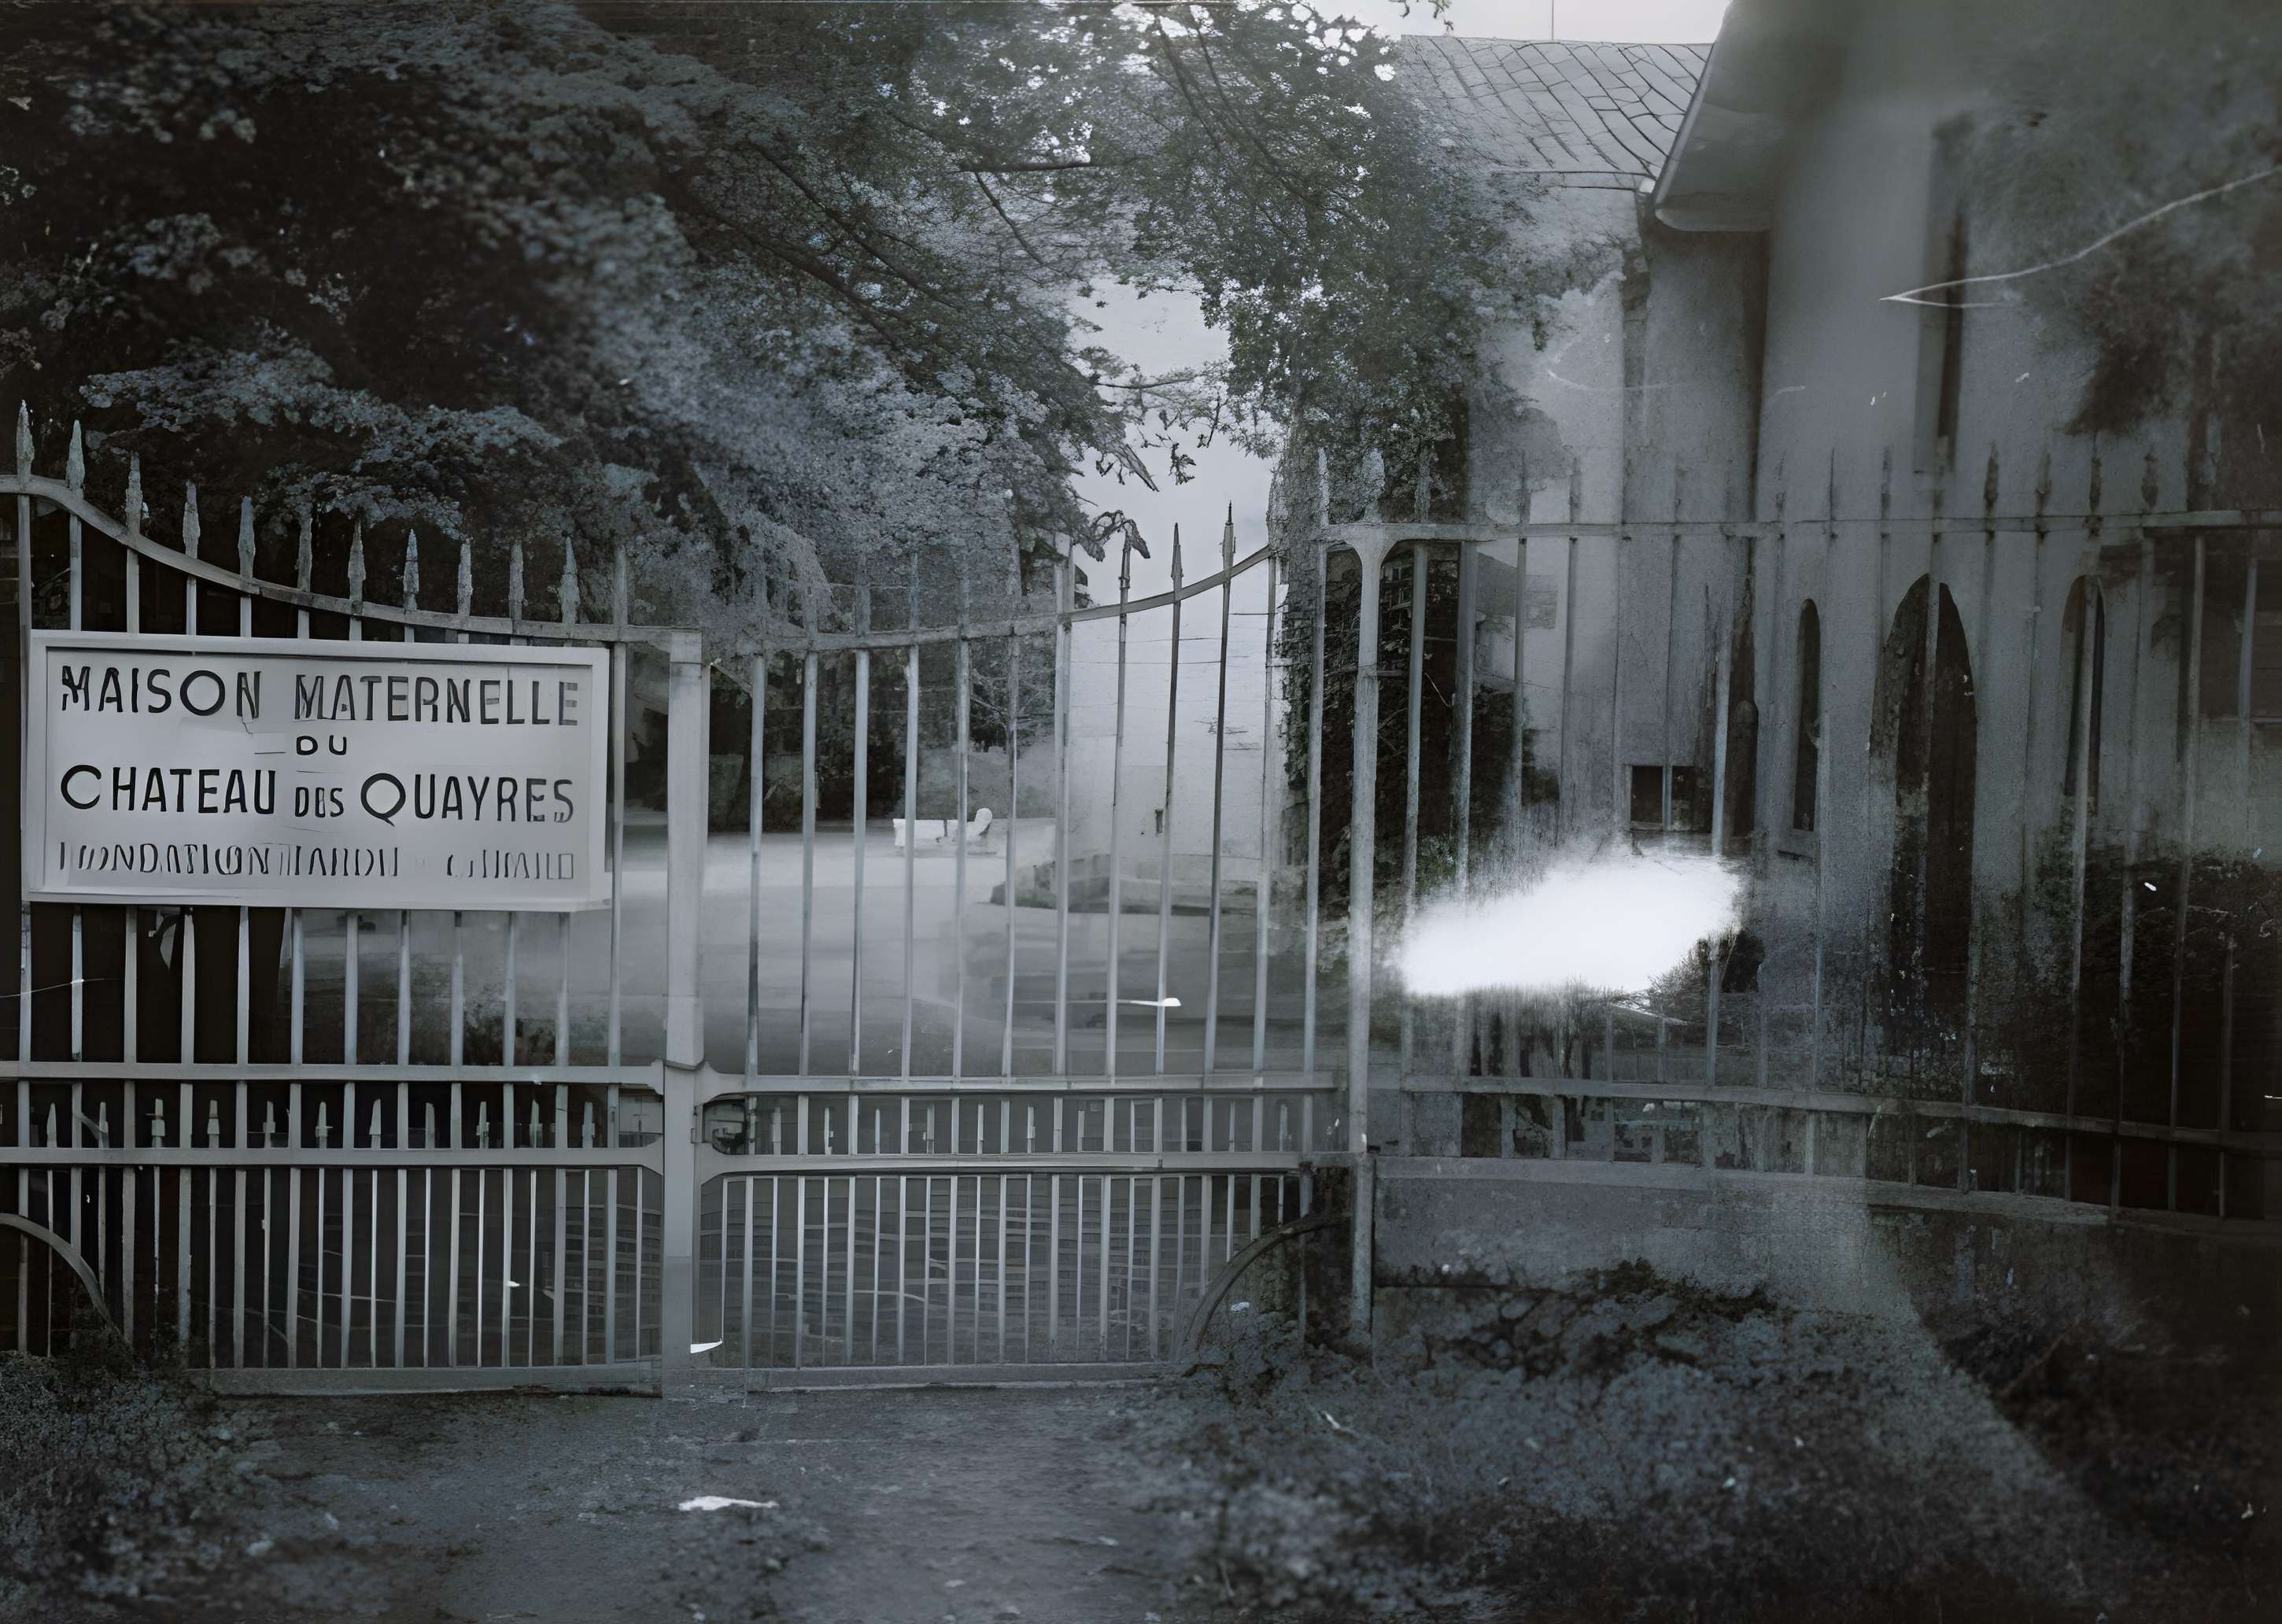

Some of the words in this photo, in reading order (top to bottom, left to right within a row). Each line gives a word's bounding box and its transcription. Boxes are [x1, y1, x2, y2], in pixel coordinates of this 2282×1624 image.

[61, 665, 262, 718] MAISON
[294, 674, 578, 725] MATERNELLE
[295, 734, 348, 756] DU
[61, 764, 276, 814] CHATEAU
[360, 772, 574, 826] QUAYRES
